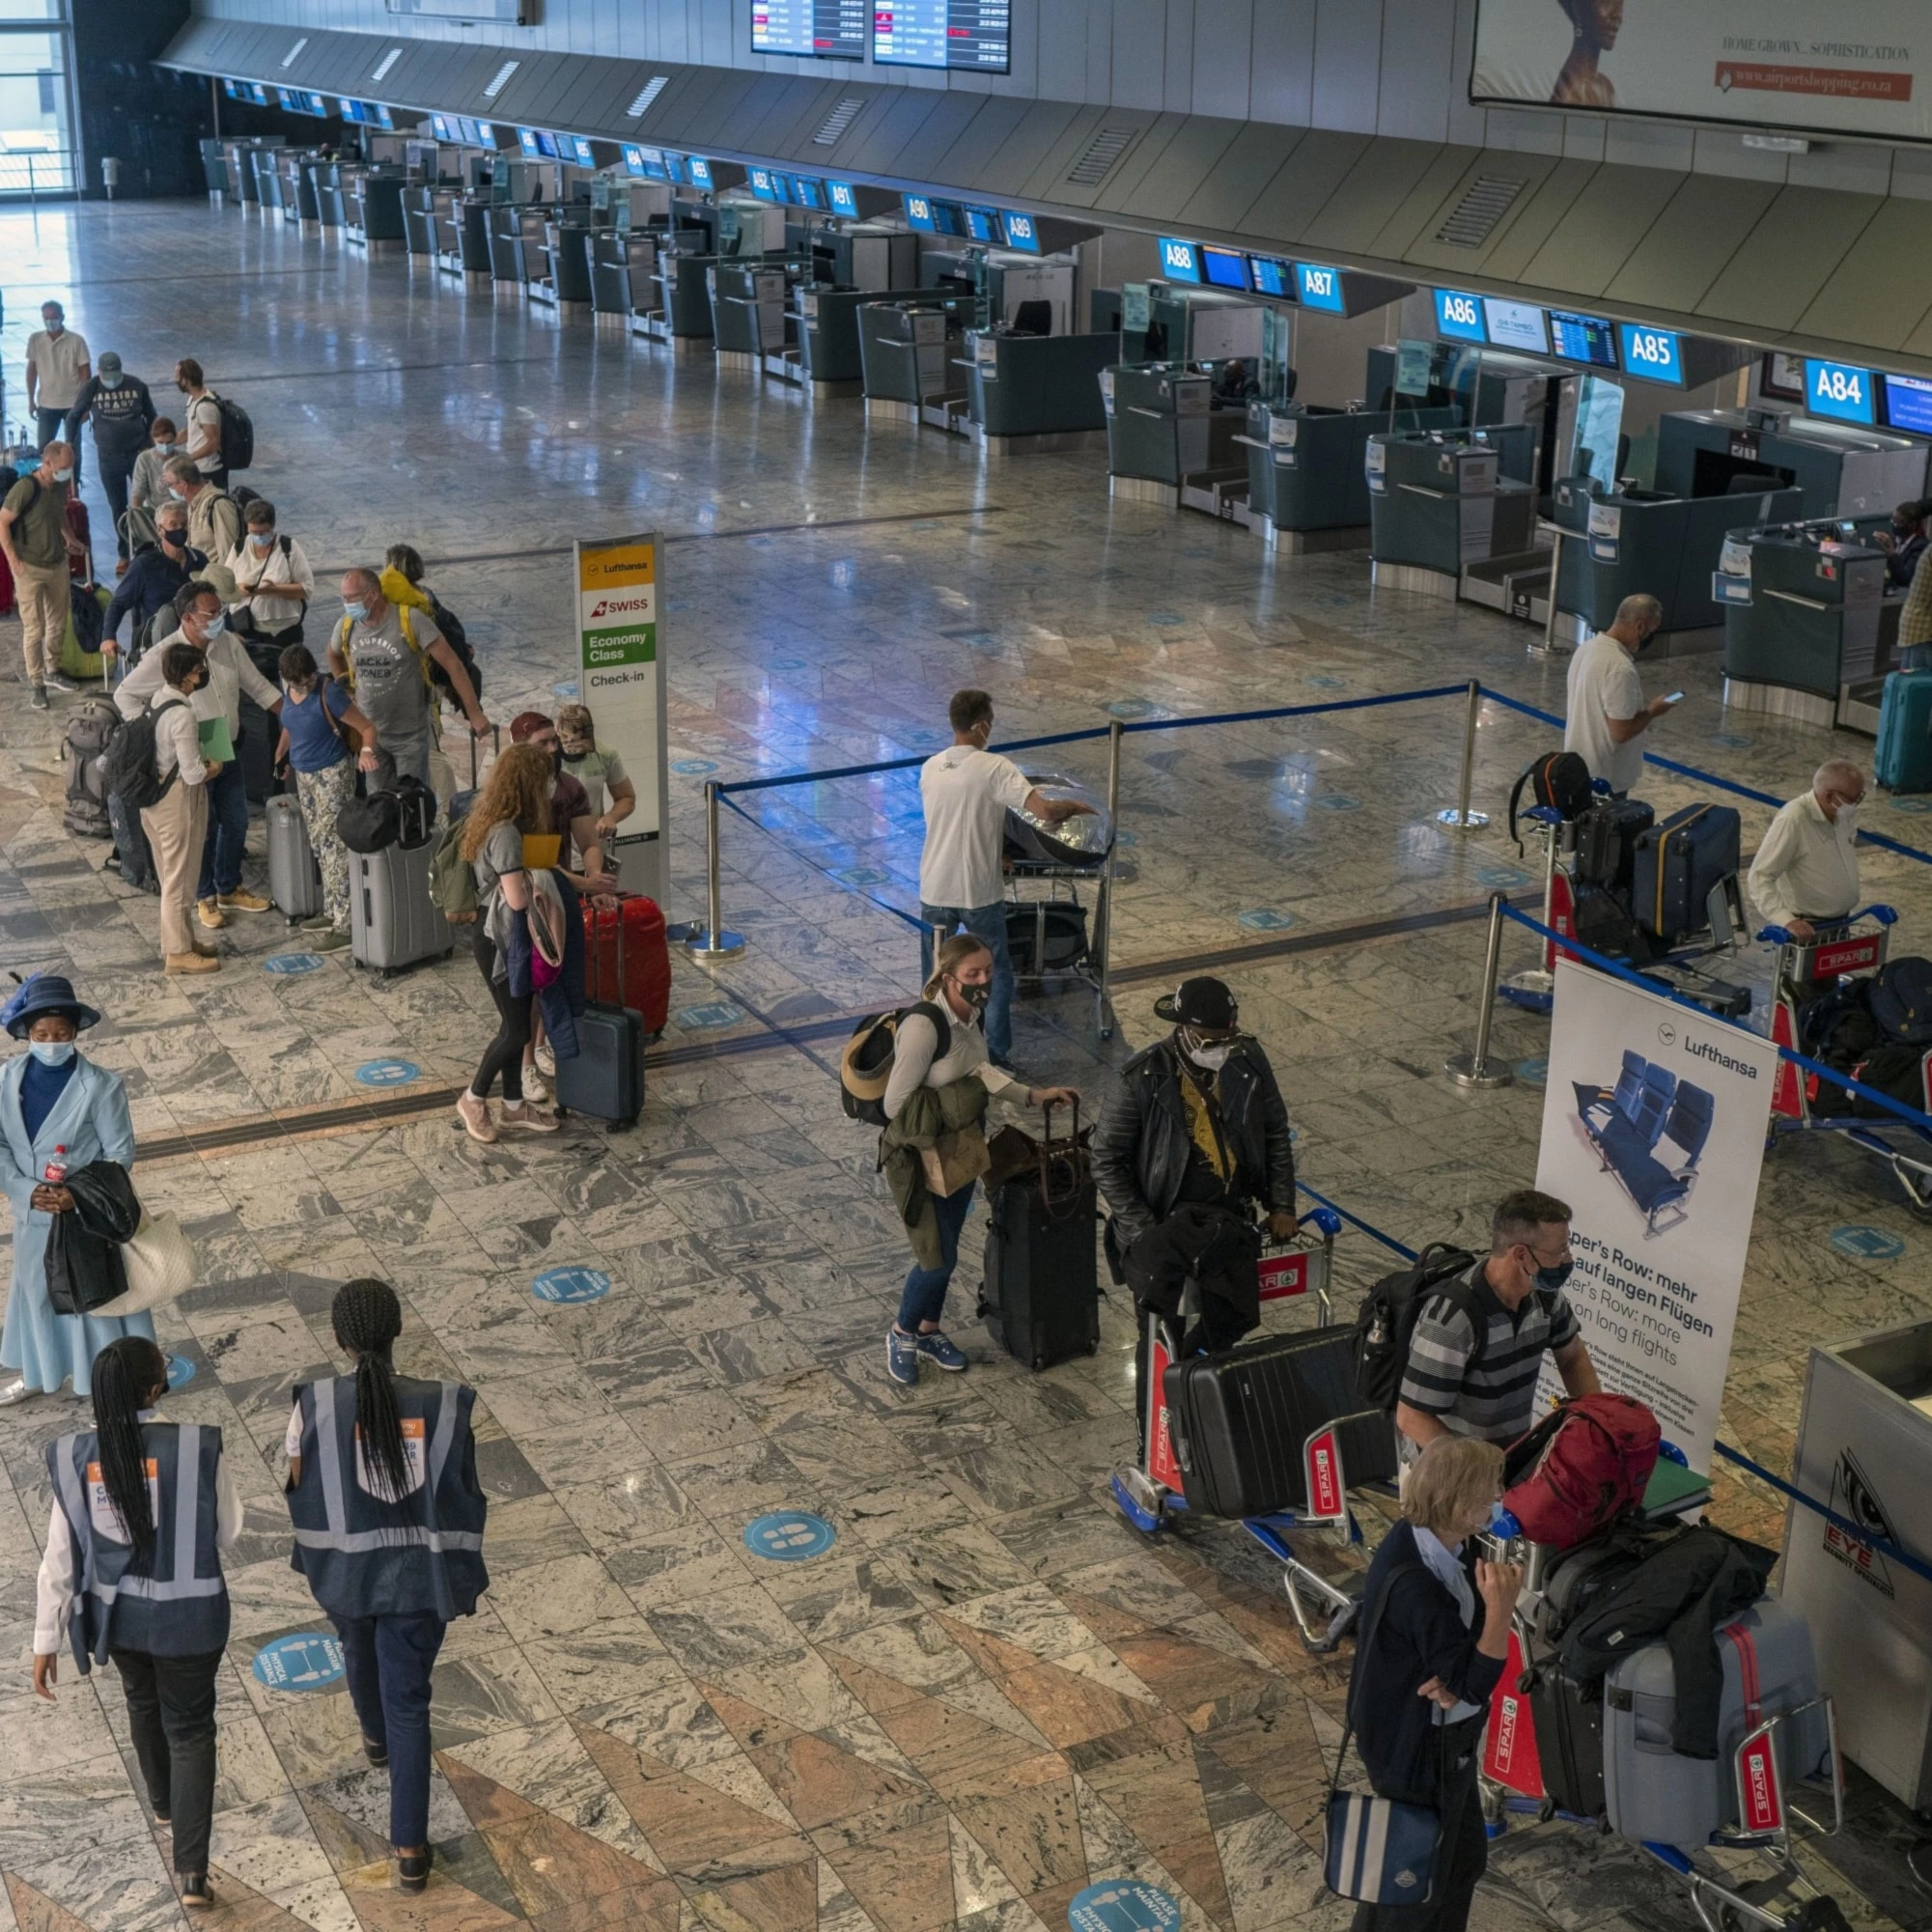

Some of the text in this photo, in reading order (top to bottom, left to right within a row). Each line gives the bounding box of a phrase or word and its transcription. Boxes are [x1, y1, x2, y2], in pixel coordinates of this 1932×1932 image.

[1723, 37, 1756, 51] HOME
[1810, 42, 1909, 60] SOPHISTICATION
[1736, 69, 1890, 94] www.airportshopping.co.za
[691, 161, 708, 179] A93
[752, 170, 770, 190] A92
[832, 185, 852, 206] A91
[909, 198, 929, 219] A90
[1009, 216, 1031, 238] A89
[1166, 243, 1192, 269] A88
[1305, 269, 1332, 296] A87
[1444, 295, 1476, 324] A86
[1633, 332, 1670, 365] A85
[1817, 368, 1862, 405] A84
[604, 561, 648, 574] Lufthansa
[609, 599, 648, 613] SWISS
[359, 637, 402, 660] SUPERIOR
[589, 632, 646, 649] Economy
[590, 649, 625, 662] Class
[591, 672, 644, 687] Check-in
[1829, 953, 1860, 966] SPAR
[1685, 1036, 1757, 1078] Lufthansa
[1259, 1274, 1277, 1288] AR
[1611, 1248, 1653, 1281] Row:
[1656, 1273, 1698, 1303] mehr
[1576, 1257, 1714, 1337] auf langen Flügen
[1601, 1291, 1638, 1322] Row:
[1642, 1313, 1681, 1343] more
[1575, 1304, 1677, 1365] on long flights
[1590, 1353, 1607, 1367] Class
[1621, 1371, 1641, 1386] ganze
[1642, 1381, 1669, 1400] Sitzreihe
[1644, 1372, 1655, 1382] auf
[1620, 1381, 1654, 1403] Verfügung
[1159, 1423, 1168, 1460] SPAR
[1322, 1464, 1330, 1498] SPAR
[1827, 1526, 1873, 1568] EYE
[259, 1654, 278, 1685] DISTANCE
[269, 1652, 288, 1683] PHYSICAL
[1498, 1715, 1515, 1758] SPAR
[1757, 1771, 1769, 1812] SPAR
[1133, 1887, 1172, 1926] MAINTAIN
[1147, 1889, 1178, 1917] PLEASE
